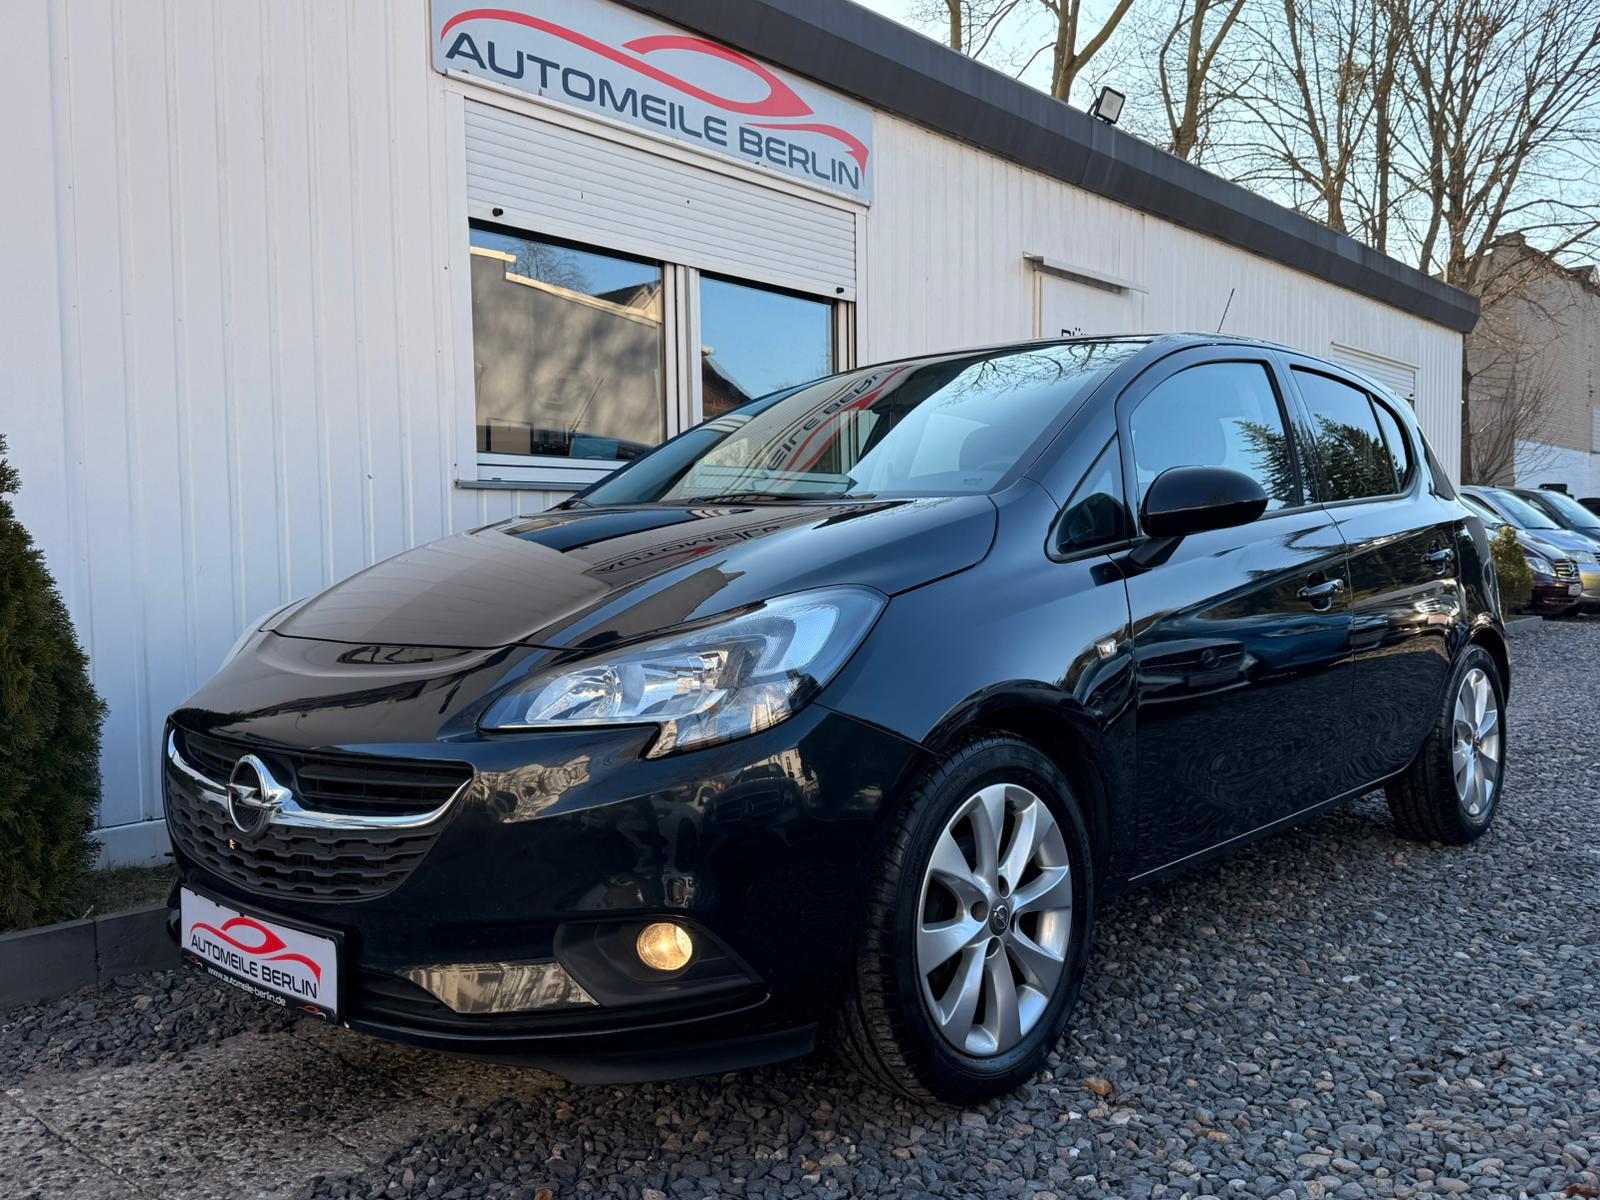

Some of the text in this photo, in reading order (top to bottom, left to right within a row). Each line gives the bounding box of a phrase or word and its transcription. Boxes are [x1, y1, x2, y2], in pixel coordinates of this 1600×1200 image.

[445, 32, 859, 190] AUTOMEILE BERLIN
[191, 934, 317, 999] AUTOMEILE BERLIN
[207, 966, 286, 1007] www.automeile-berlin.de
